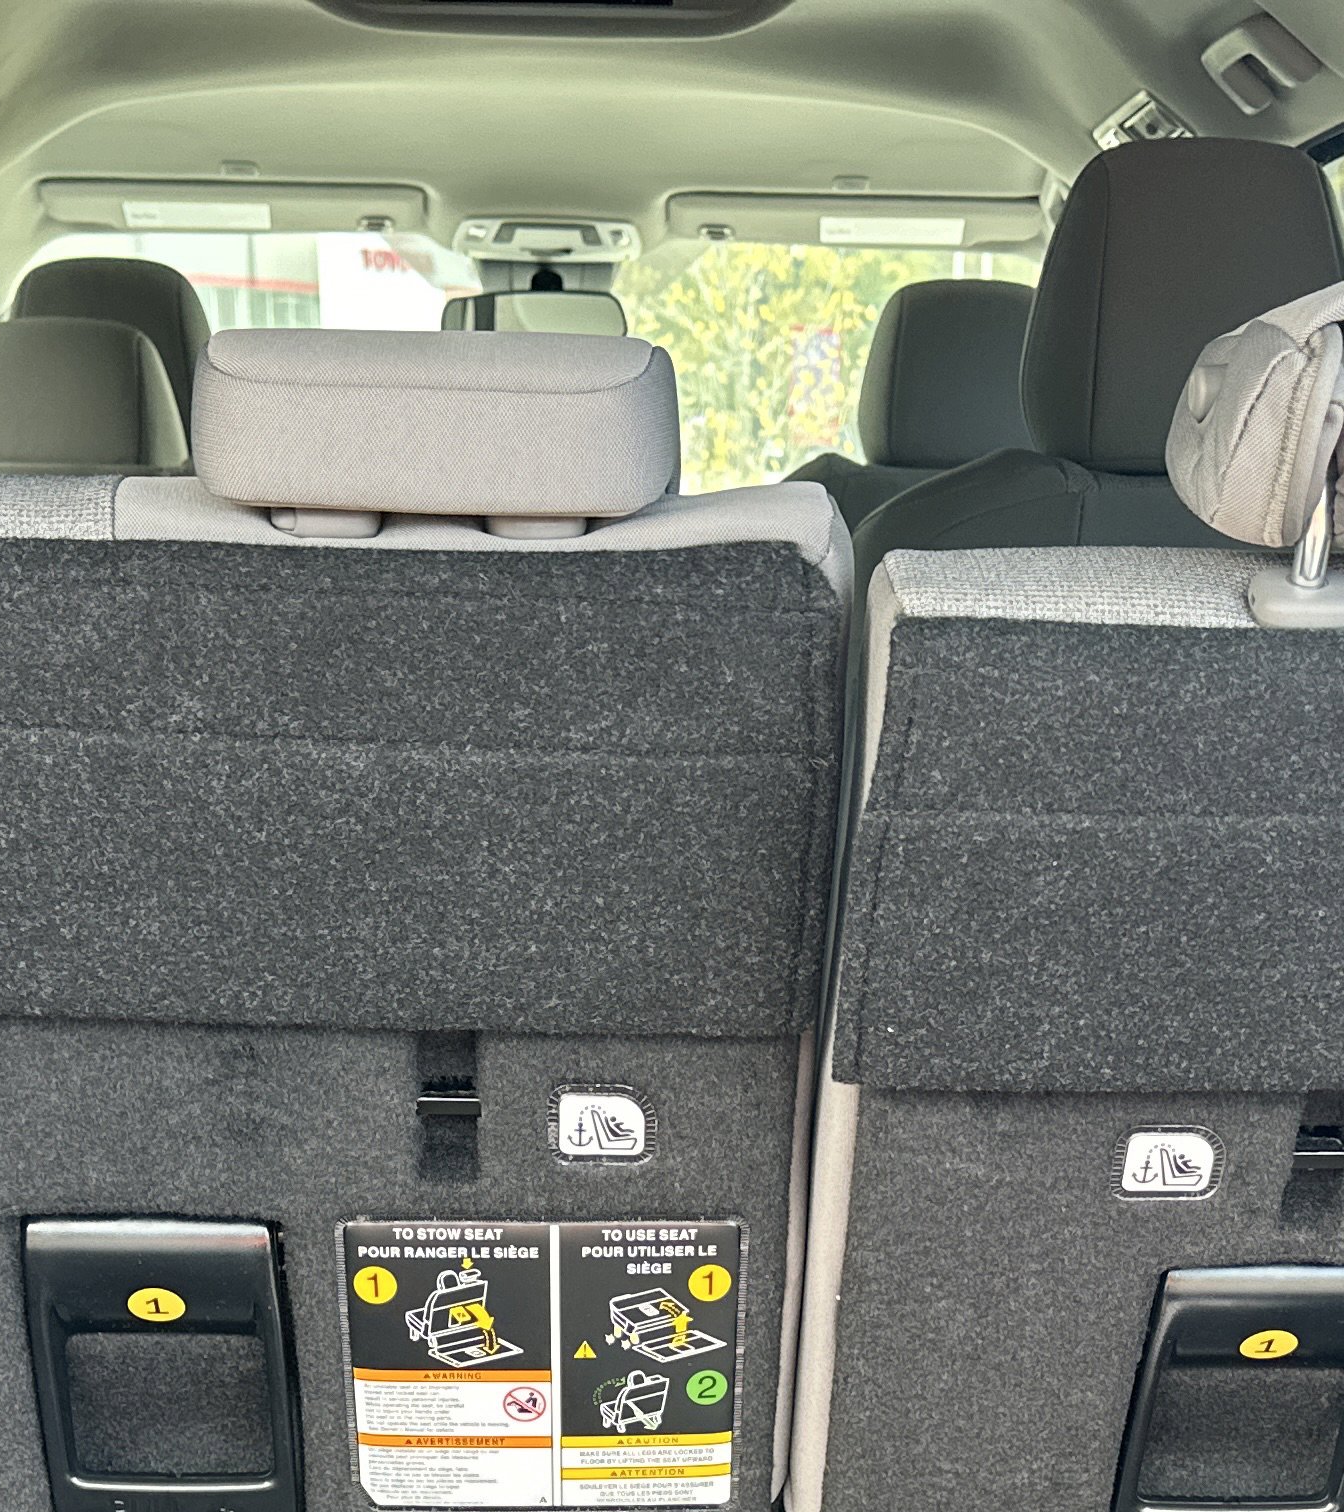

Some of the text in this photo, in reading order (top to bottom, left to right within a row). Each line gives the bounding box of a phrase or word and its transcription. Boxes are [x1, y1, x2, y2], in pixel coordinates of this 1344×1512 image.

[392, 1227, 504, 1241] TO STOW SEAT
[602, 1228, 698, 1241] TO USE SEAT
[358, 1244, 539, 1259] POUR RANGER LE SIÈGE
[581, 1245, 718, 1258] POUR UTILISER LE
[626, 1261, 672, 1275] SIÈGE
[367, 1273, 379, 1298] 1
[702, 1271, 713, 1295] 1
[145, 1297, 170, 1315] 1
[432, 1372, 482, 1380] WARNING
[697, 1375, 717, 1399] 2
[415, 1437, 506, 1446] AVERTISSEMENT
[626, 1437, 679, 1445] CAUTION
[619, 1468, 685, 1477] ATTENTION
